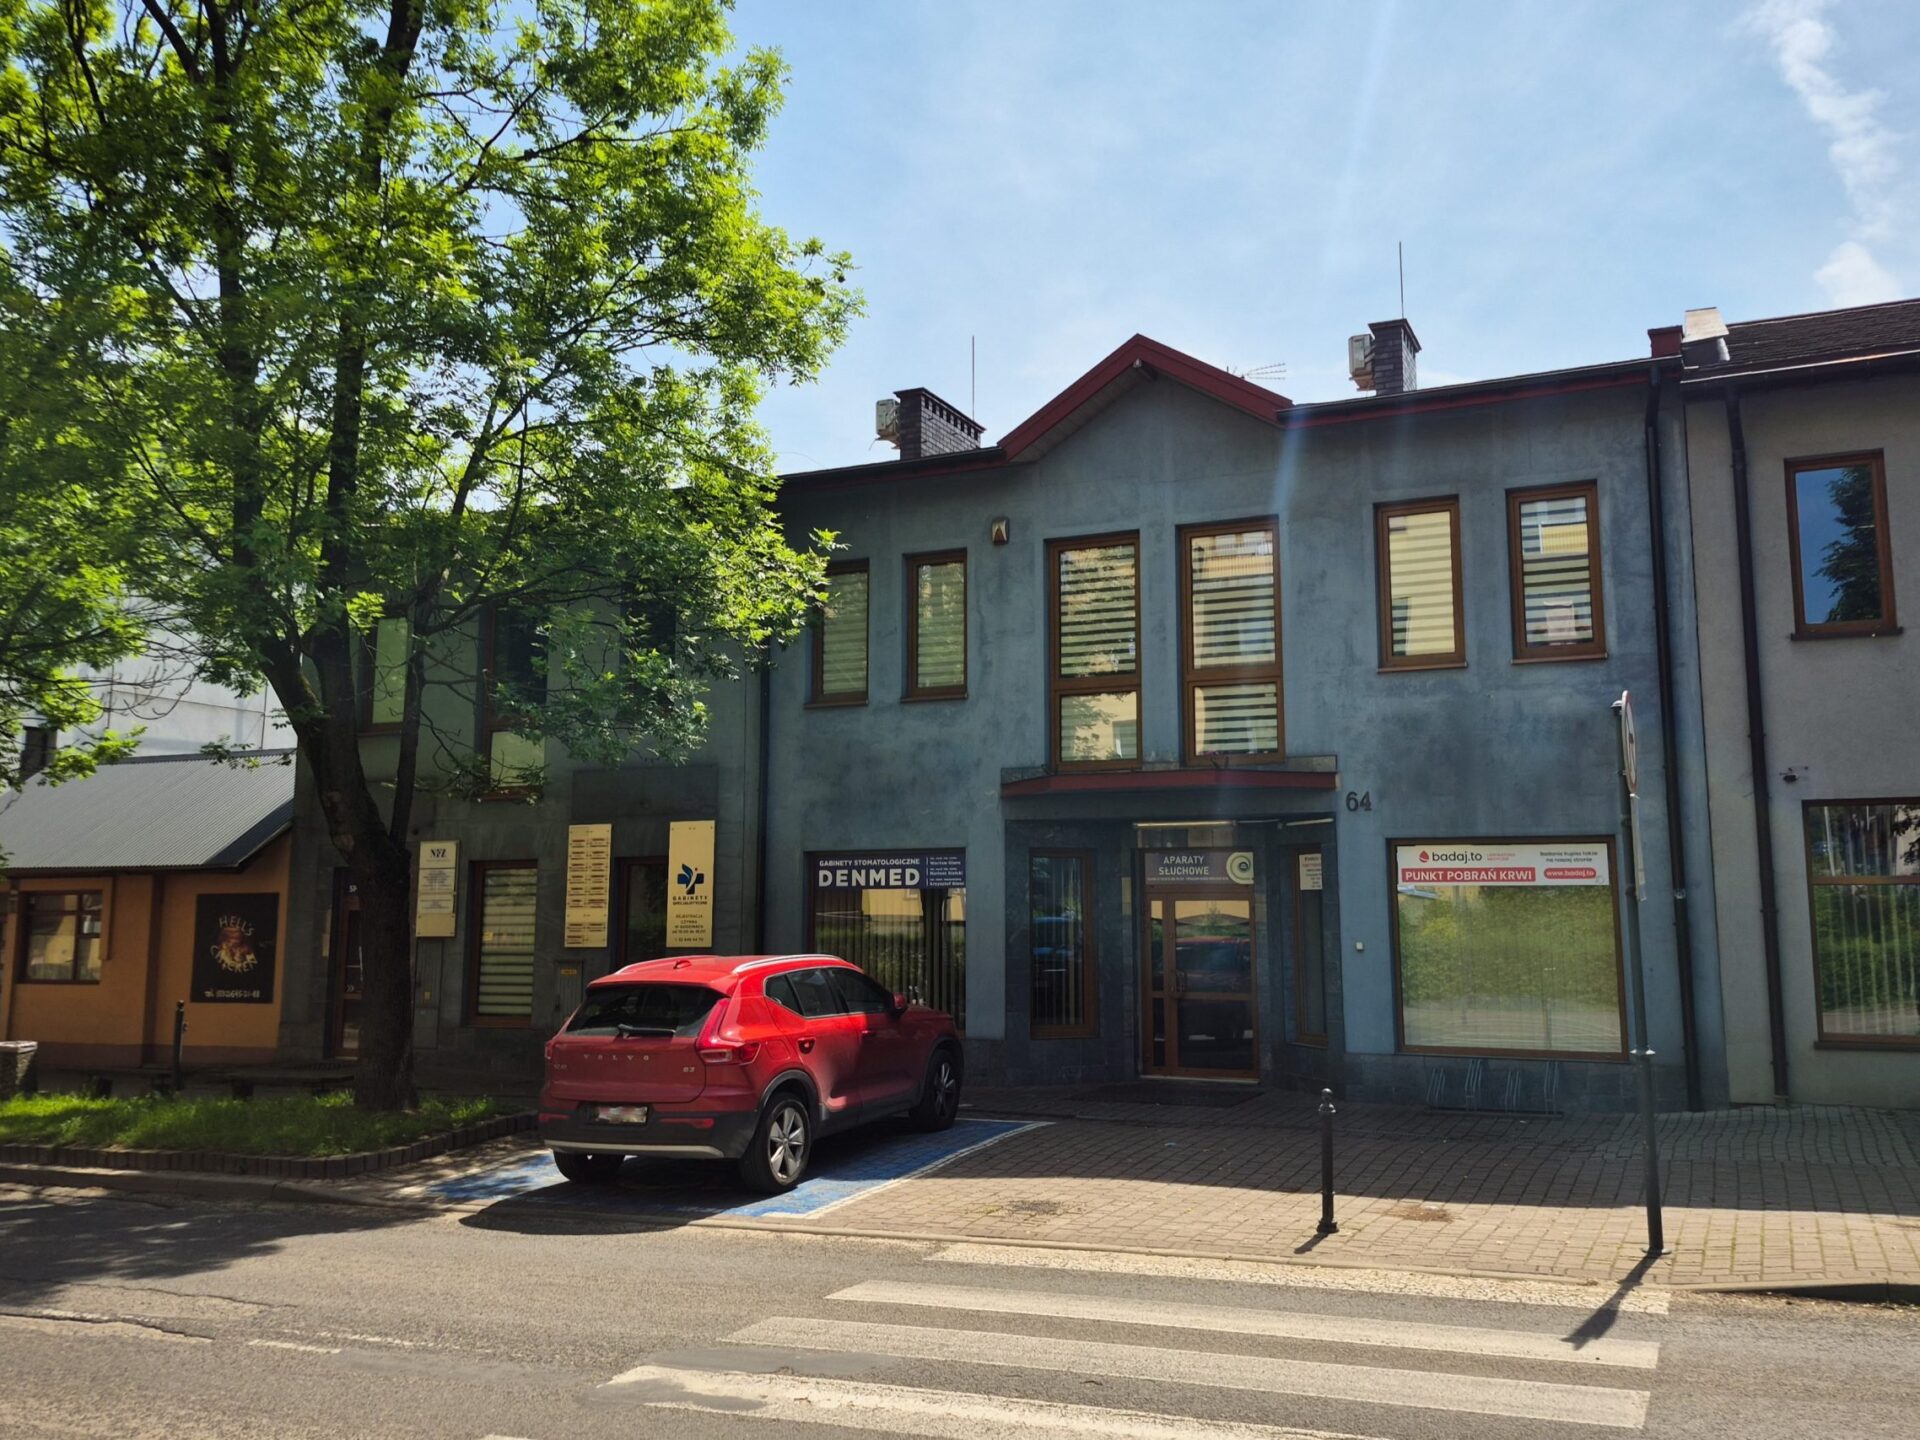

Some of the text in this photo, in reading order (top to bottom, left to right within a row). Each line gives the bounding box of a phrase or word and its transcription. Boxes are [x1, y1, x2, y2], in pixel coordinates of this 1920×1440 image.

[1345, 791, 1372, 811] 64
[430, 848, 447, 858] NFZ
[1432, 851, 1483, 864] badaj.to
[819, 858, 920, 867] GABINETY STOMATOLOGICZNE
[1163, 855, 1205, 865] APARATY
[1158, 866, 1209, 875] SŁUCHOWE
[1405, 867, 1532, 881] PUNKT POBRAŃ KRWI
[818, 868, 921, 887] DENMED
